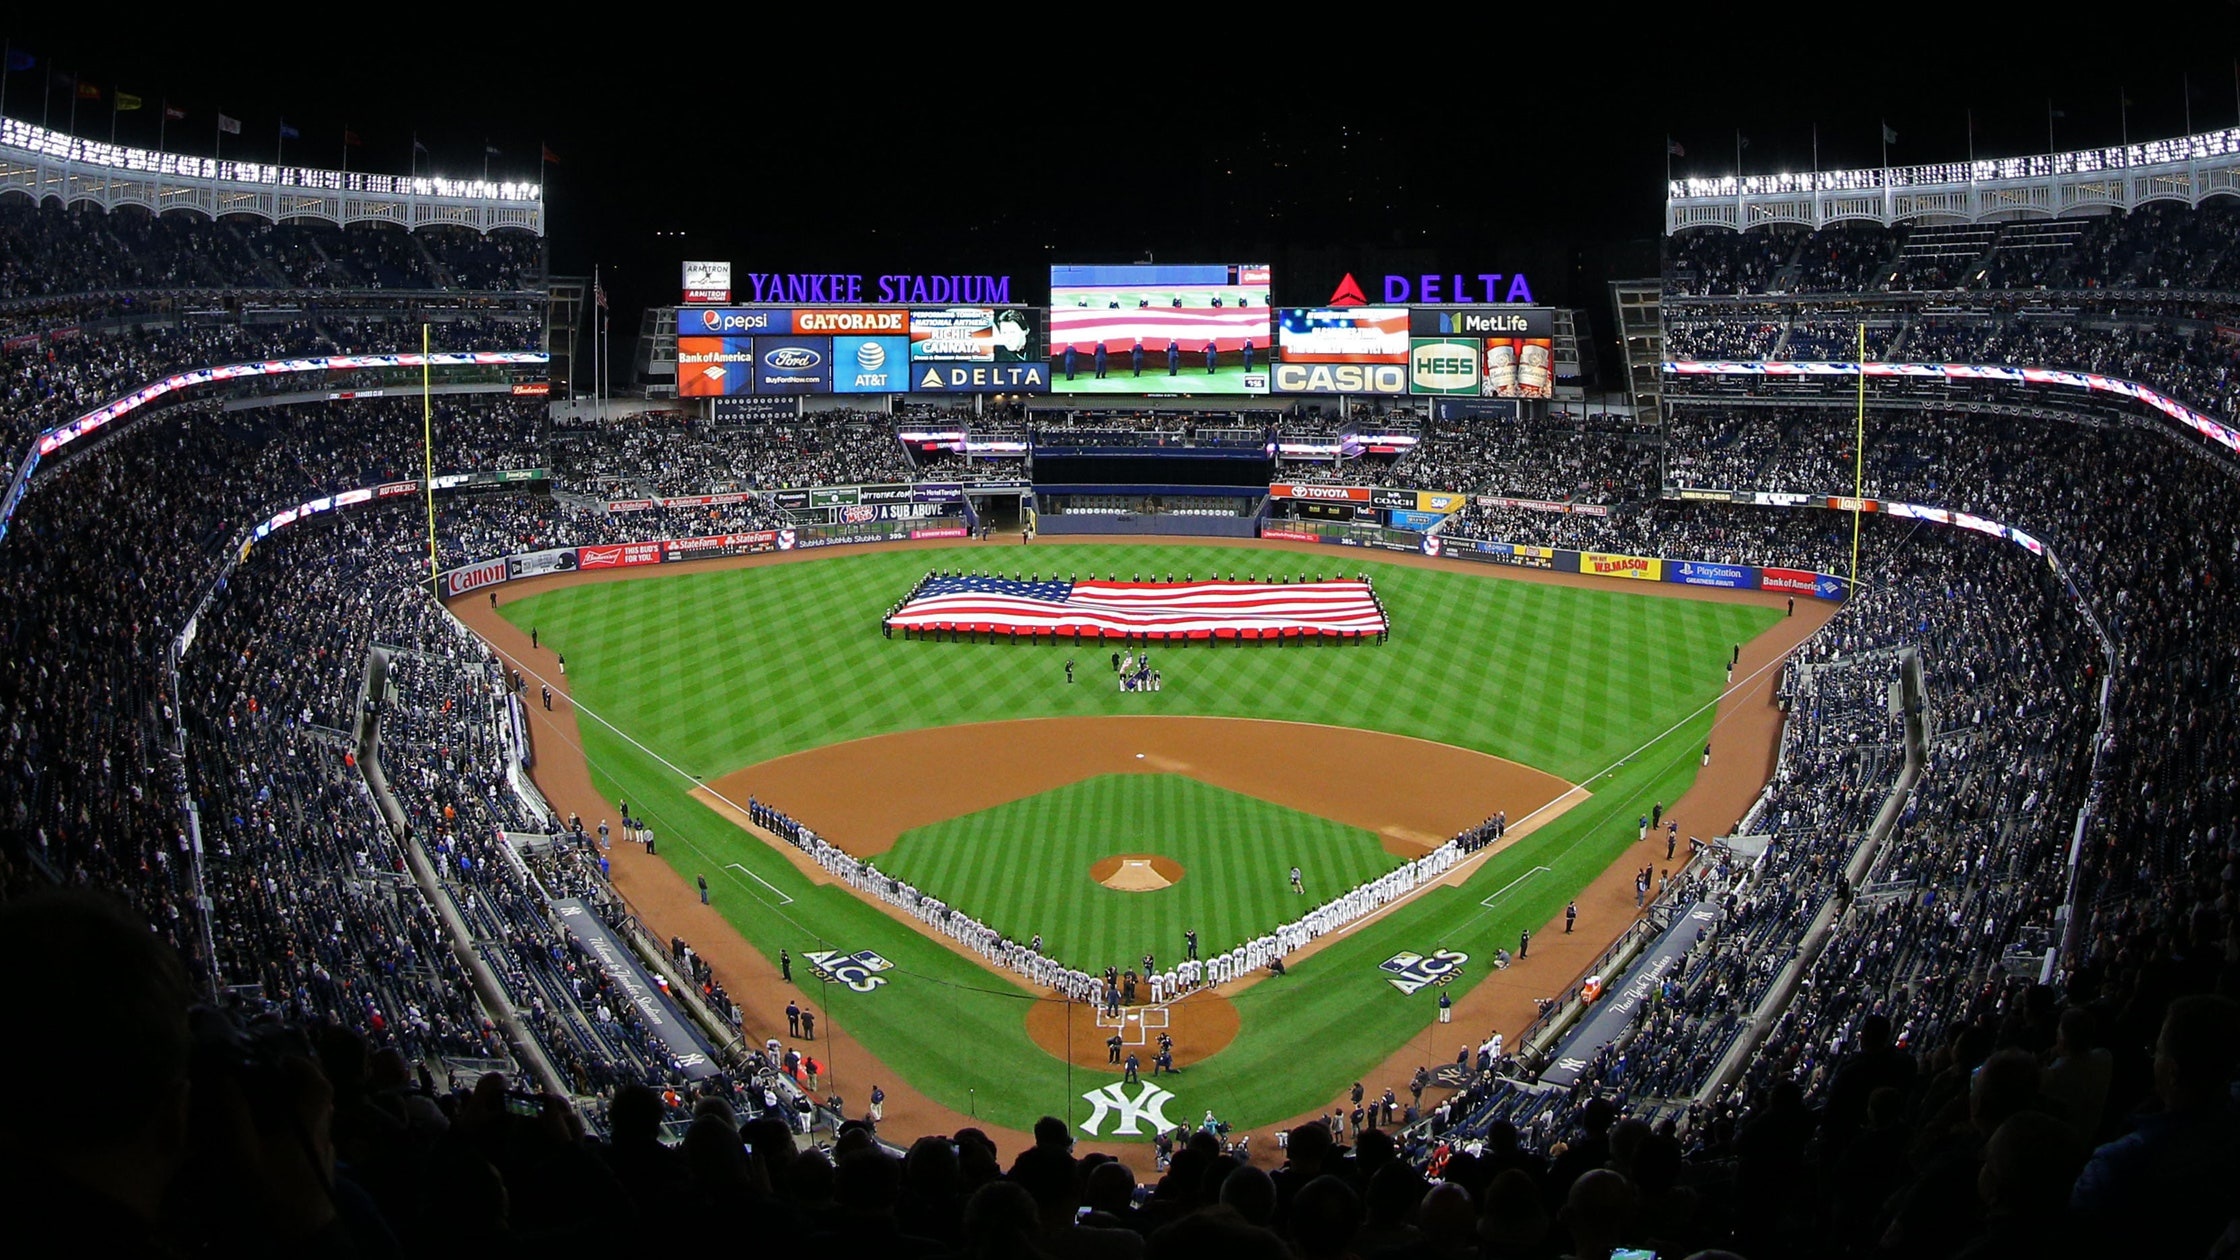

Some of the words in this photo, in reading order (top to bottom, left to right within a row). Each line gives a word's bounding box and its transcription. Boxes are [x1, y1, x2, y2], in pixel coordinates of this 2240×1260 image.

[687, 265, 728, 273] ARMITRON
[748, 273, 862, 303] YANKEE
[878, 274, 1010, 304] STADIUM
[1385, 274, 1533, 303] DELTA
[724, 313, 767, 331] pepsi
[800, 313, 902, 331] GATORADE
[1466, 315, 1528, 331] MetLife
[921, 341, 981, 353] CANNATA
[679, 353, 701, 363] Bank
[702, 353, 713, 363] of
[713, 353, 751, 363] America
[775, 350, 810, 366] Ford
[1418, 358, 1473, 374] HESS
[855, 374, 888, 387] AT&T
[951, 369, 1042, 385] DELTA
[1277, 365, 1405, 392] CASIO
[379, 483, 416, 496] RUTGERS
[1308, 488, 1349, 498] TOYOTA
[1374, 497, 1414, 506] COACH
[1431, 497, 1448, 508] SAP
[881, 505, 888, 519] A
[890, 504, 910, 518] SUB
[912, 503, 943, 516] ABOVE
[1357, 507, 1376, 515] FedEx
[800, 540, 825, 548] StubHub
[826, 537, 852, 545] StubHub
[854, 534, 881, 542] StubHub
[624, 546, 639, 555] THIS
[640, 544, 659, 553] BUD'S
[625, 555, 638, 563] FOR
[450, 563, 505, 592] Canon
[1696, 565, 1742, 578] PlayStation
[1763, 577, 1783, 586] Bank
[1784, 578, 1792, 587] of
[1792, 580, 1821, 591] America
[1608, 996, 1635, 1014] New
[1623, 979, 1650, 1000] York
[1638, 955, 1672, 983] Yankees
